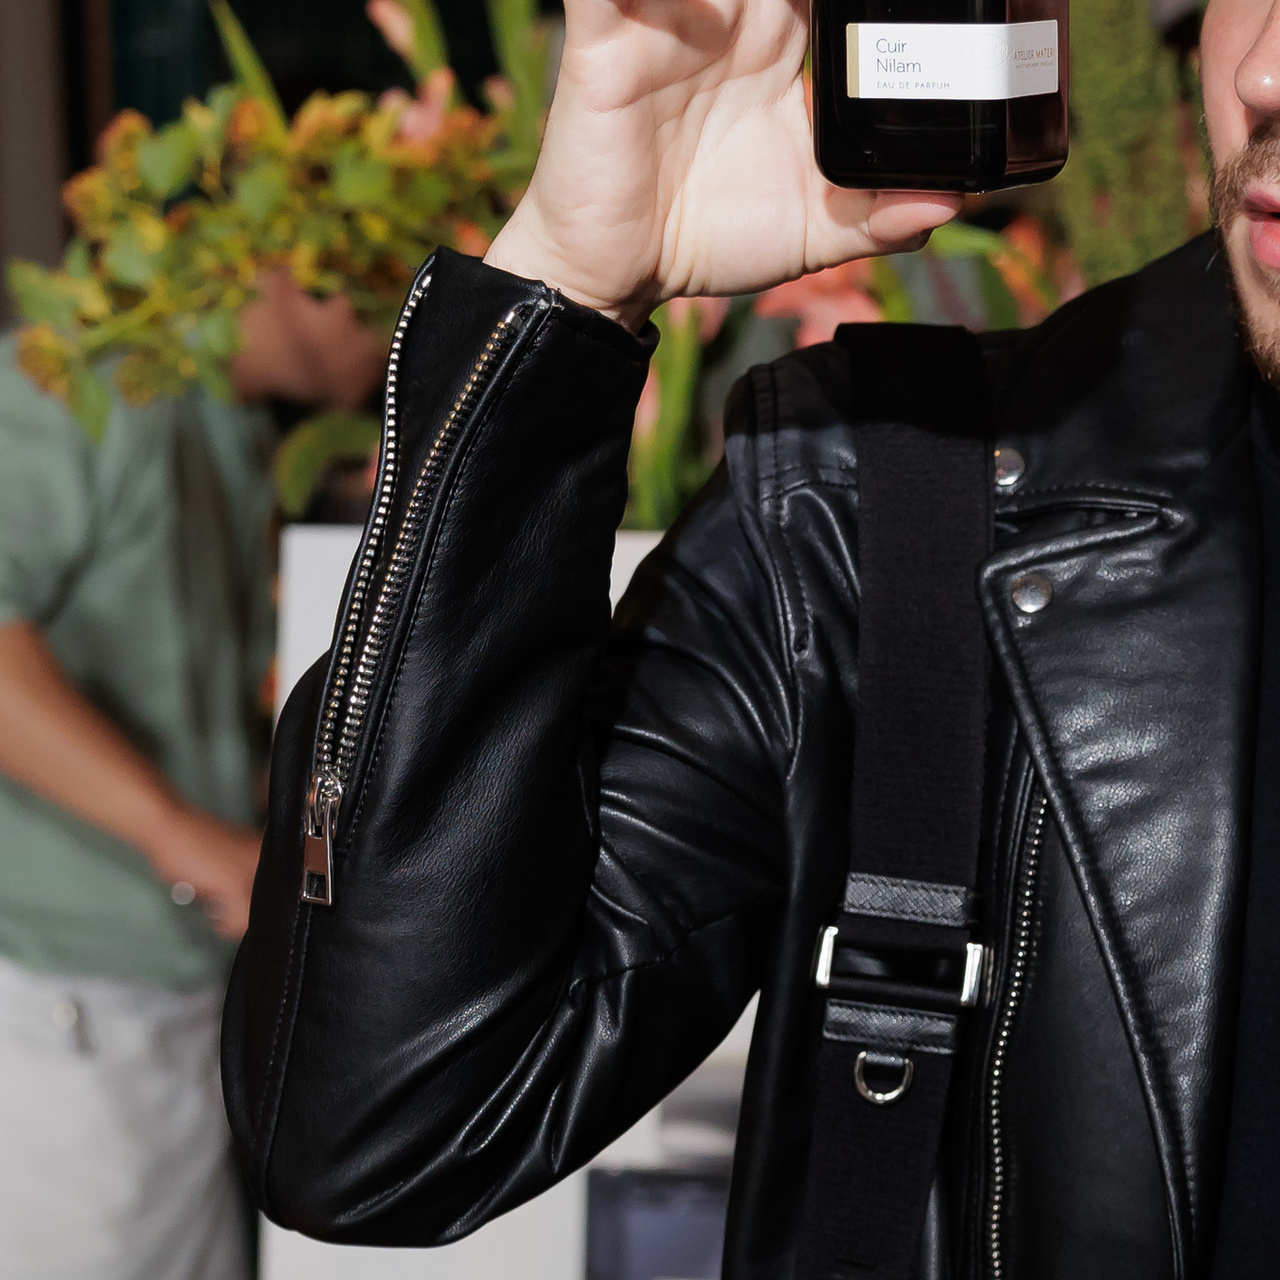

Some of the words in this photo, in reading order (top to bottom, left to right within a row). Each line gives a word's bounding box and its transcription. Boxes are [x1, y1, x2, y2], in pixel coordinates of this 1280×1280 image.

[876, 38, 907, 53] Cuir
[1013, 49, 1035, 61] ATELIER
[876, 58, 922, 73] Nilam
[877, 81, 895, 90] EAU
[899, 81, 910, 90] DE
[915, 81, 950, 90] PARFUM
